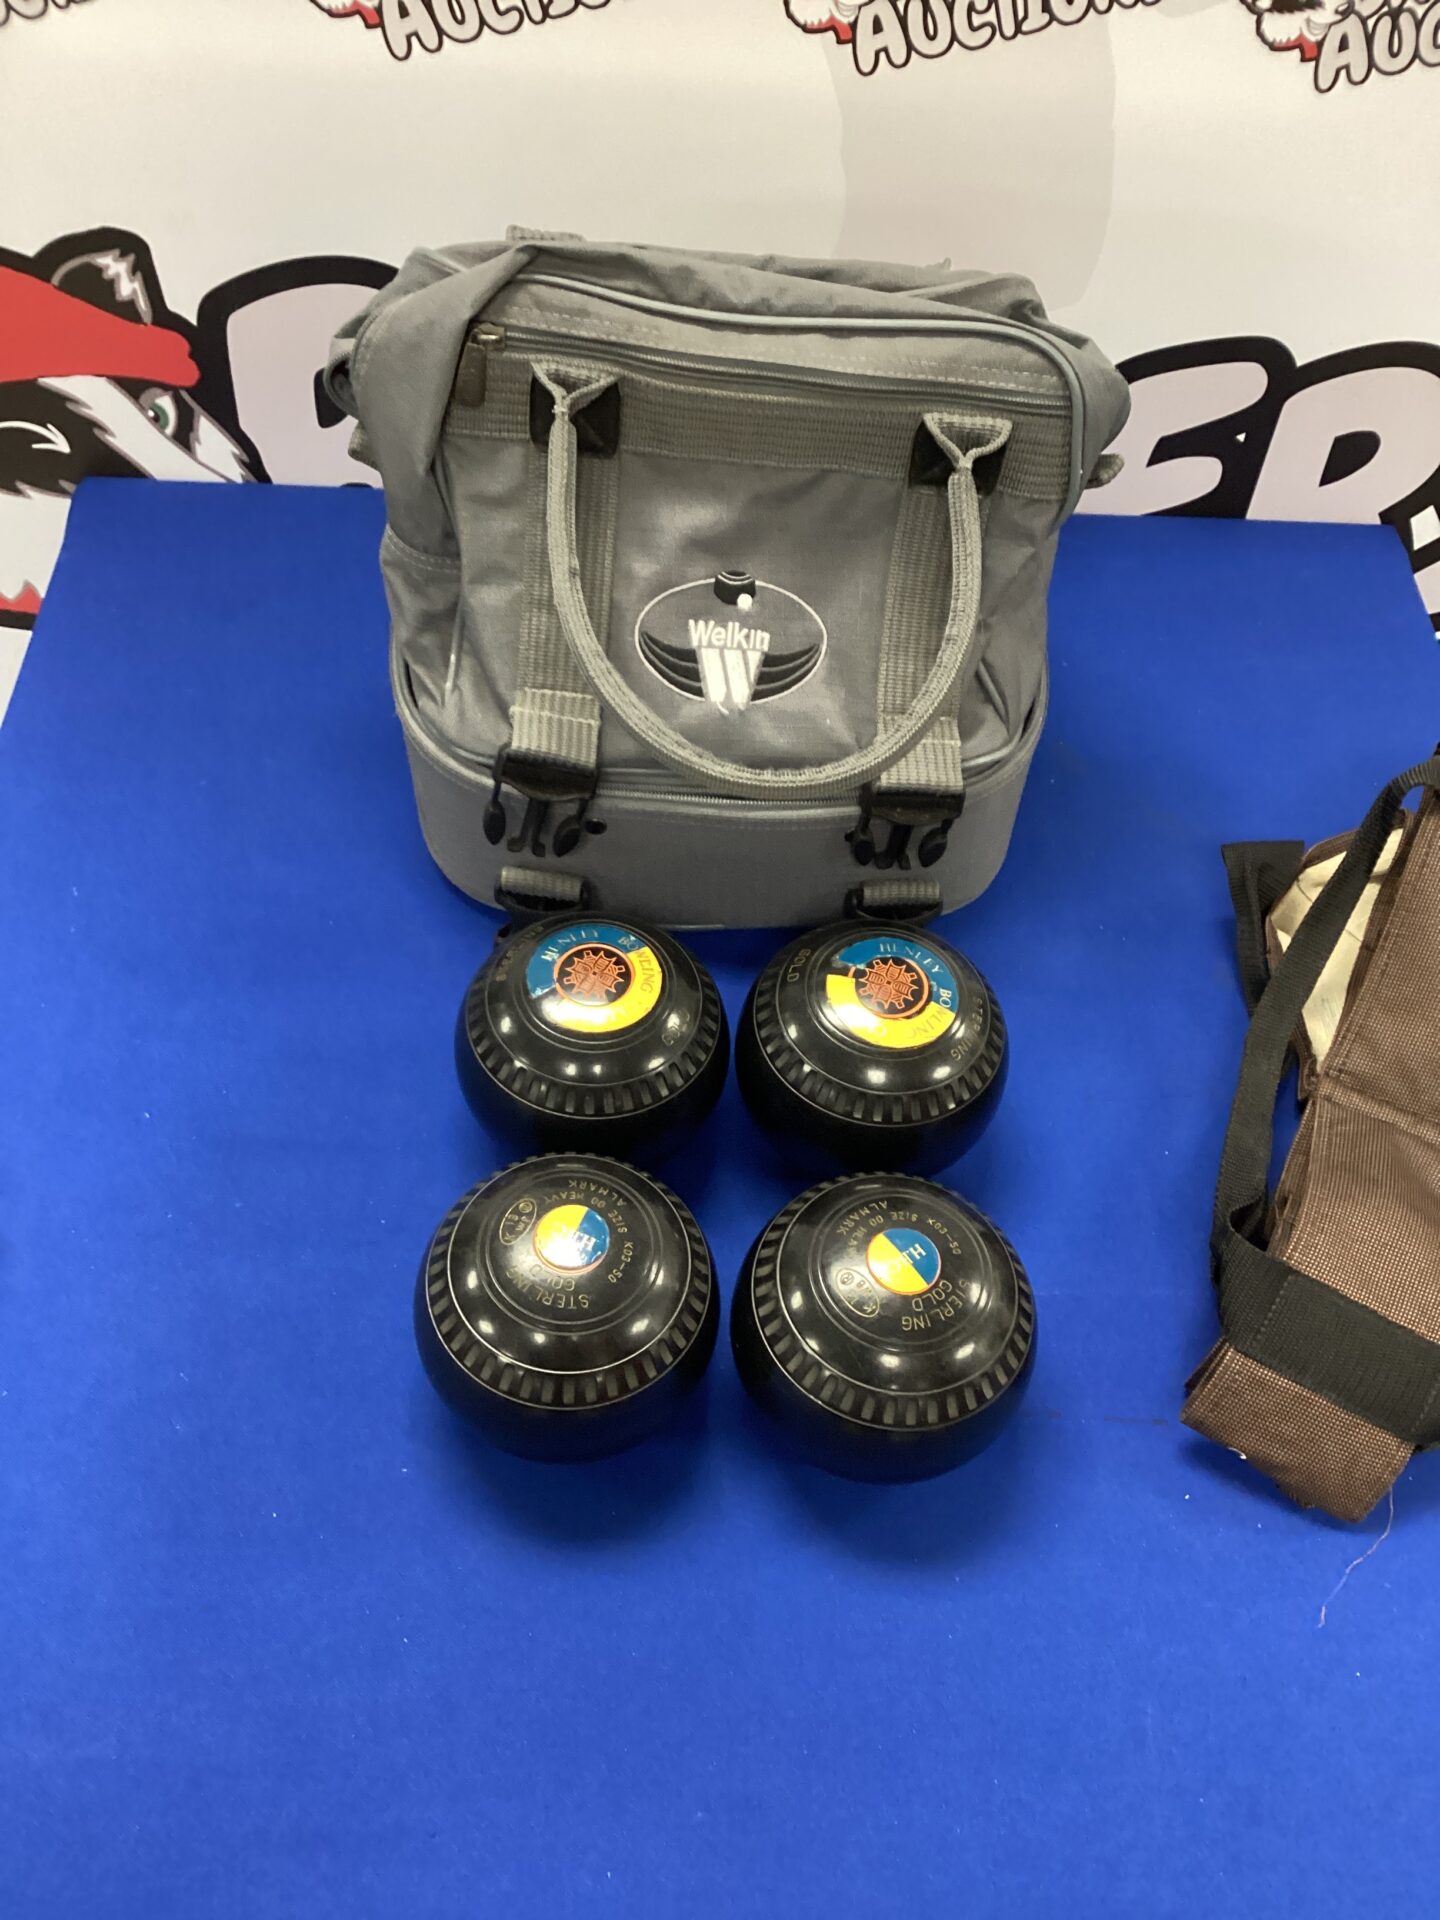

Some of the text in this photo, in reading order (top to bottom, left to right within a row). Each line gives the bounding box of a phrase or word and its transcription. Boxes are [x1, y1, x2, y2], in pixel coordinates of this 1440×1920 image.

[688, 619, 771, 652] Welkin
[786, 948, 812, 983] GOLD
[569, 1179, 628, 1207] ALMARK
[607, 1209, 628, 1233] SIZE
[836, 1200, 888, 1235] ALMARK
[911, 1279, 953, 1311] GOLD
